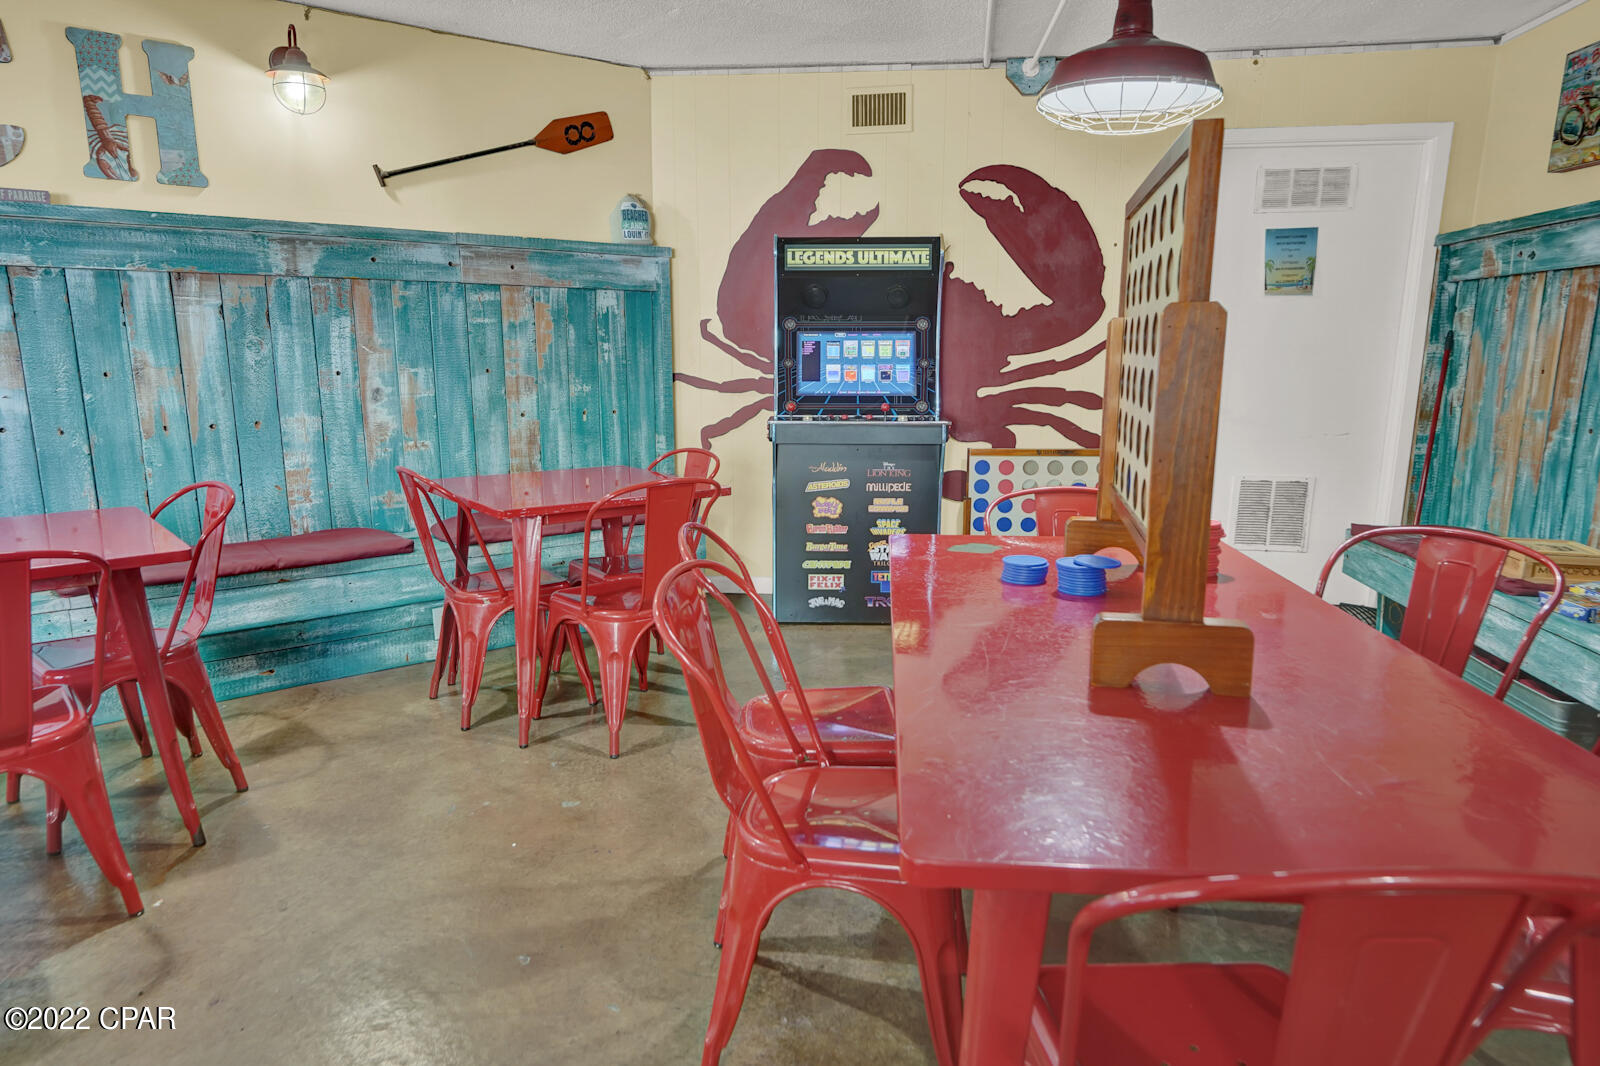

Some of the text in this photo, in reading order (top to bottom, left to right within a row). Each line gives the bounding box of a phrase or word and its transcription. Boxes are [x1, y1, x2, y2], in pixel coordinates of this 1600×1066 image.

[7, 189, 48, 203] PARADISE
[622, 209, 648, 221] BEACHED
[787, 249, 930, 265] LEGENDS ULTIMATE
[807, 480, 849, 491] ASTEROIDS
[876, 519, 902, 528] SPACE
